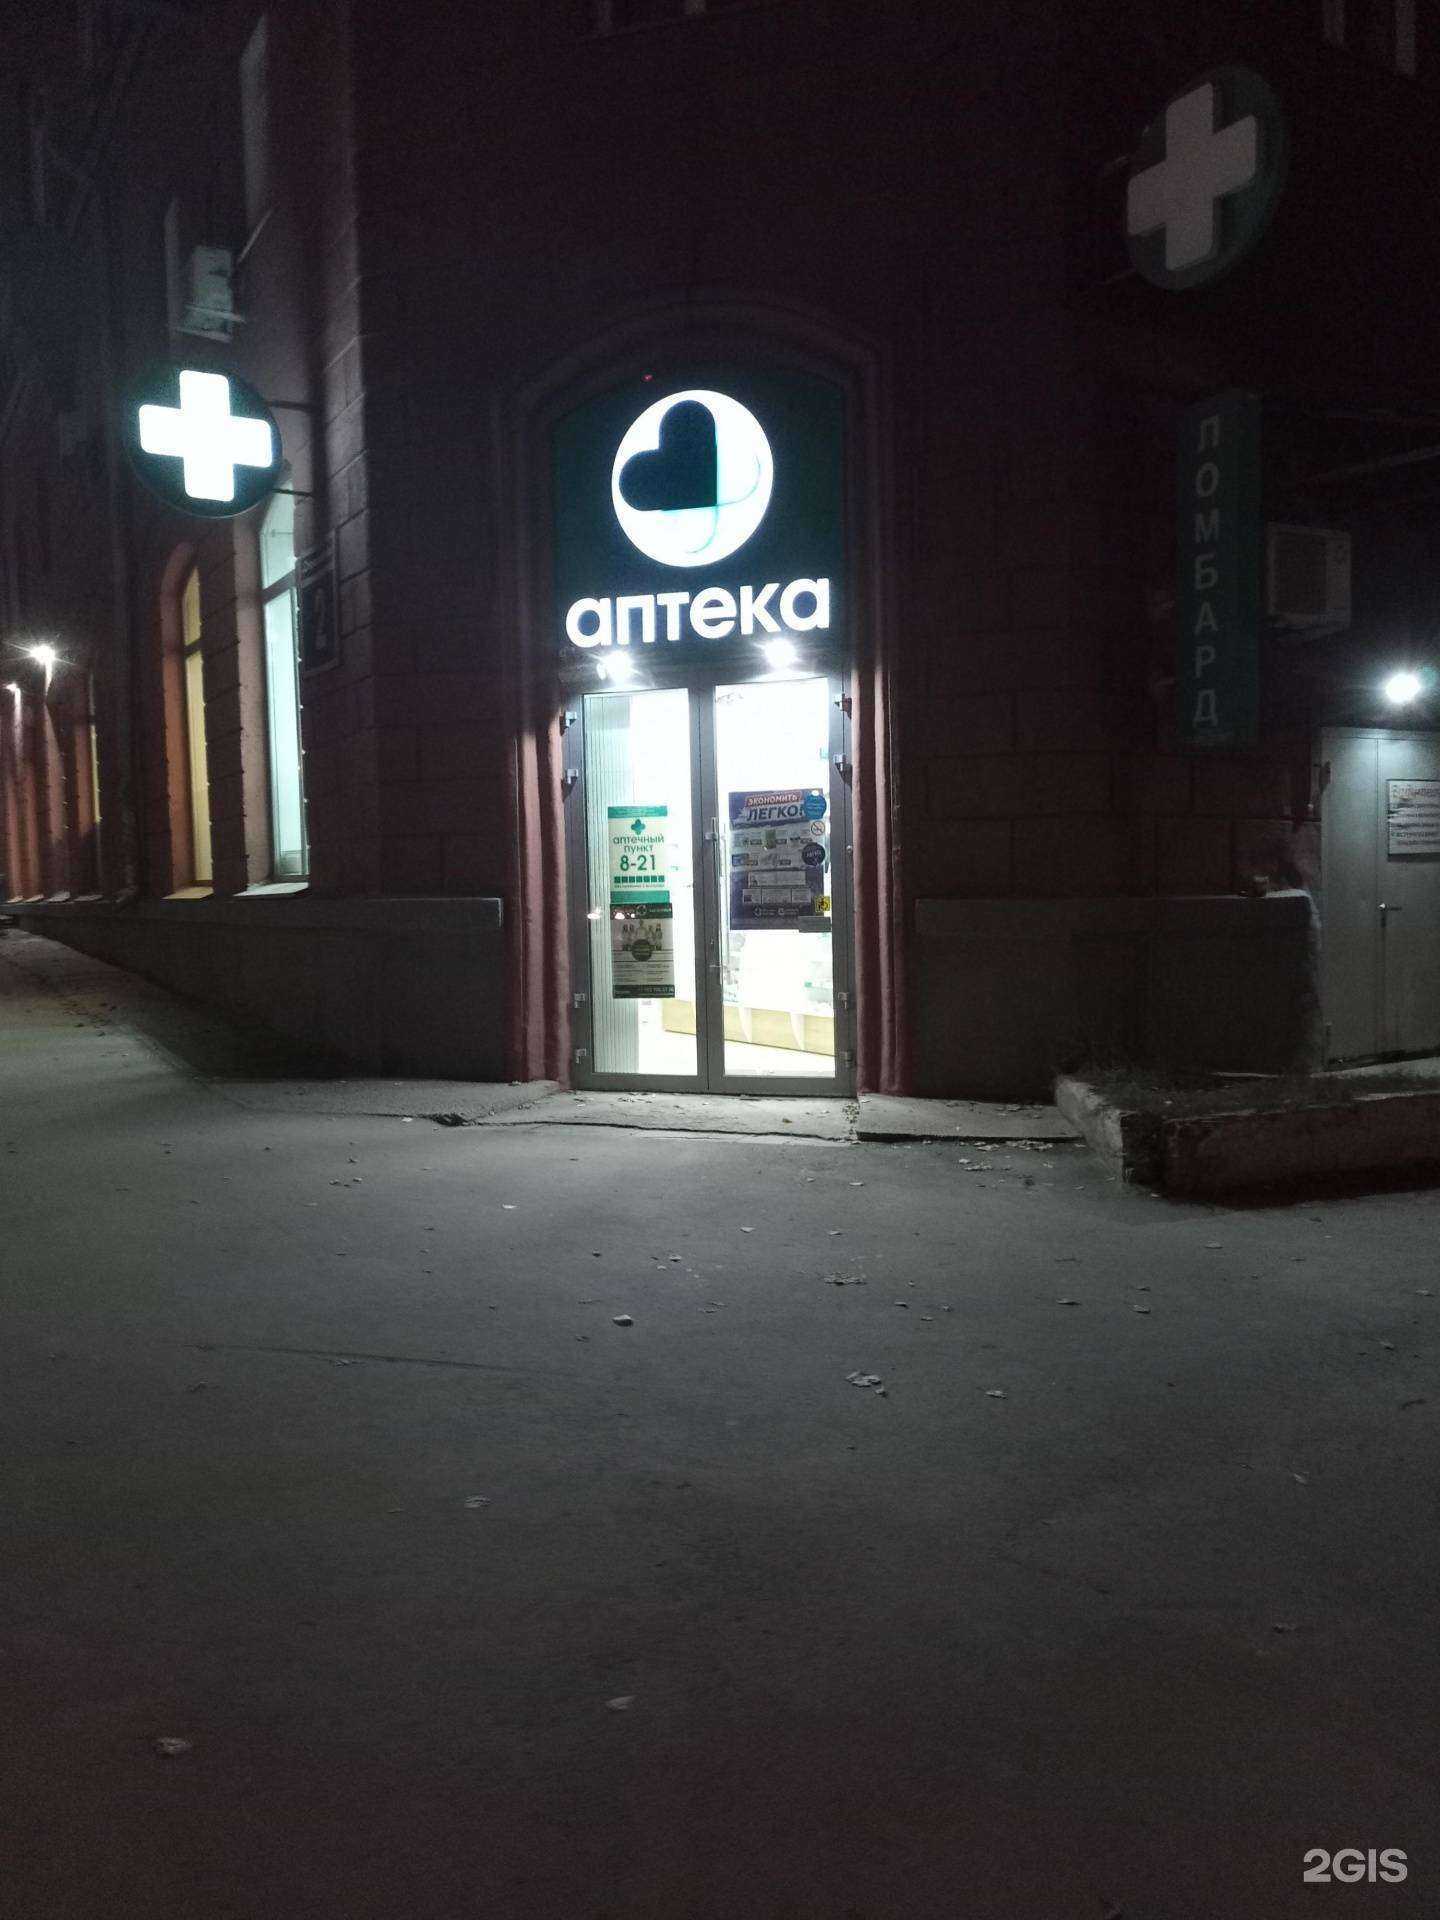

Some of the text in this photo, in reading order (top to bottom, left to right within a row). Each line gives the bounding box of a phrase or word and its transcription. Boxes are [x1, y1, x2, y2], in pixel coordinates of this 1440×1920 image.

[1192, 414, 1221, 729] ЛОМБАРД
[565, 577, 831, 649] аптека
[747, 793, 799, 807] ЭКОНОМИТЬ
[613, 833, 665, 845] аптечный
[623, 845, 654, 855] пункт
[620, 854, 655, 871] 8-21
